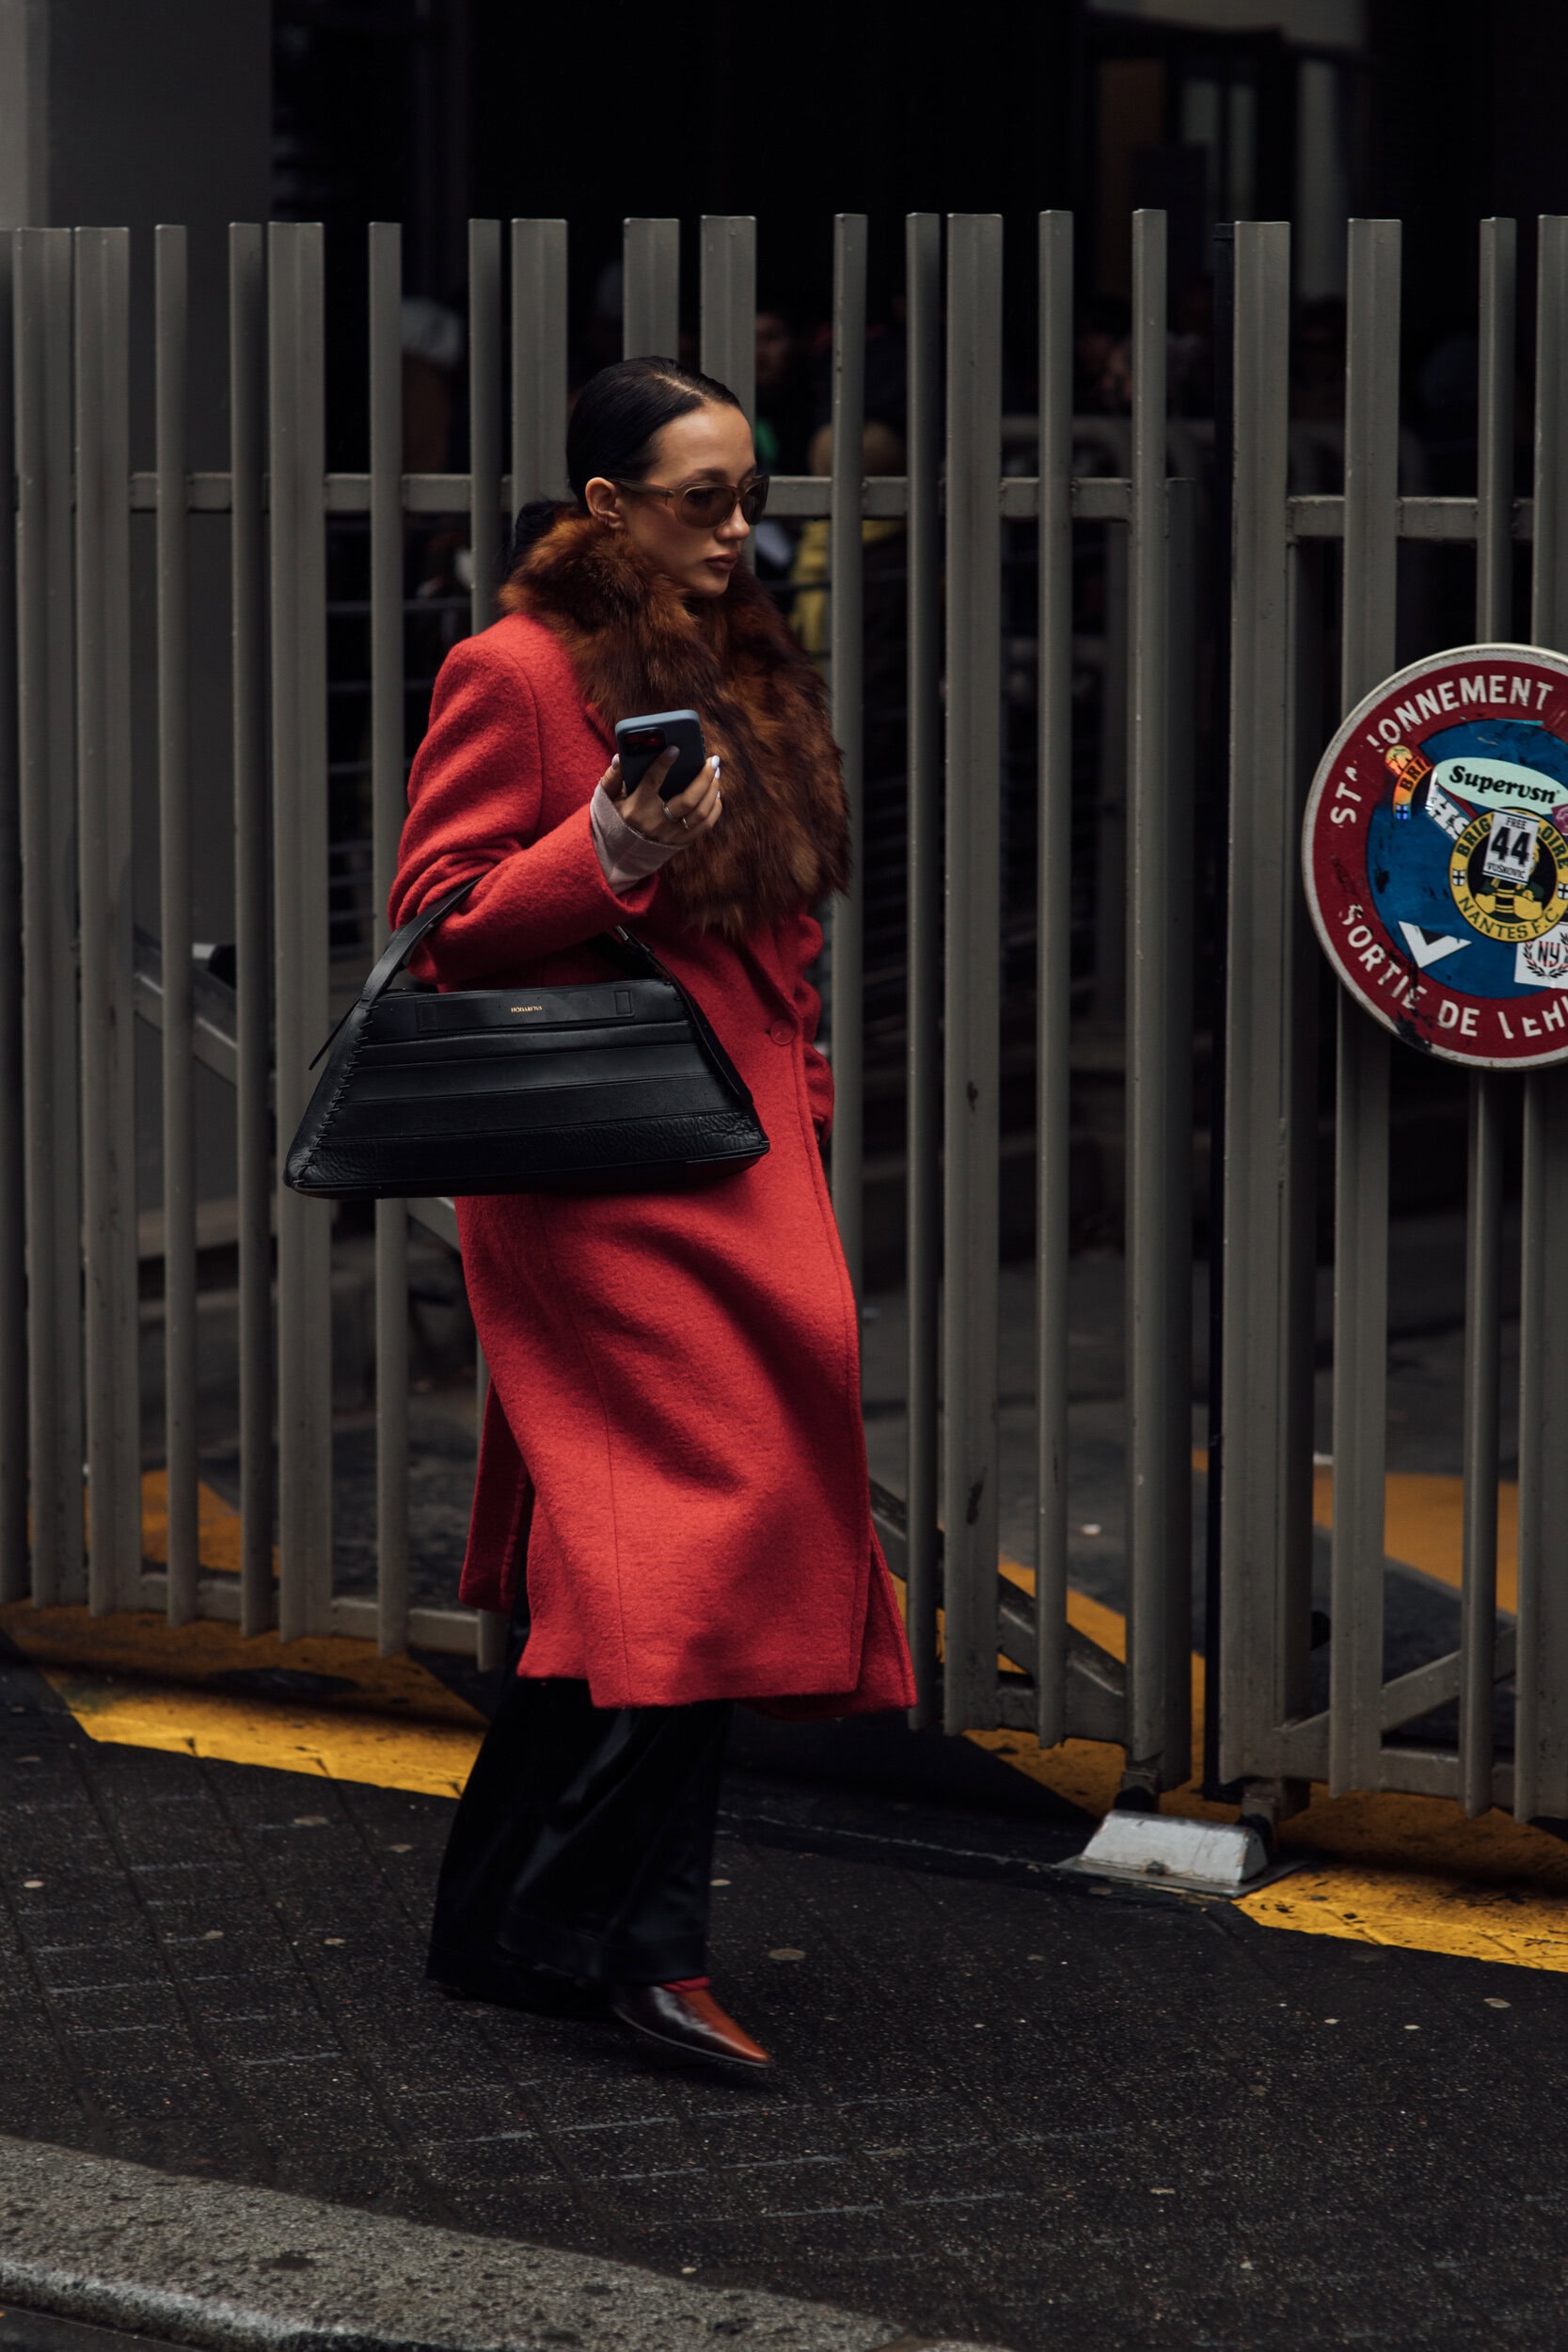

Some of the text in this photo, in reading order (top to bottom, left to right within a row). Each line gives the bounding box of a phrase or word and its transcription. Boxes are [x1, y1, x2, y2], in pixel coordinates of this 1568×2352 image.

[1455, 813, 1568, 869] BRIG OIRE
[1506, 817, 1528, 830] FREE
[1491, 827, 1530, 866] 44
[1459, 897, 1528, 939] NANTES
[1538, 941, 1560, 967] NY
[1437, 999, 1481, 1038] DE
